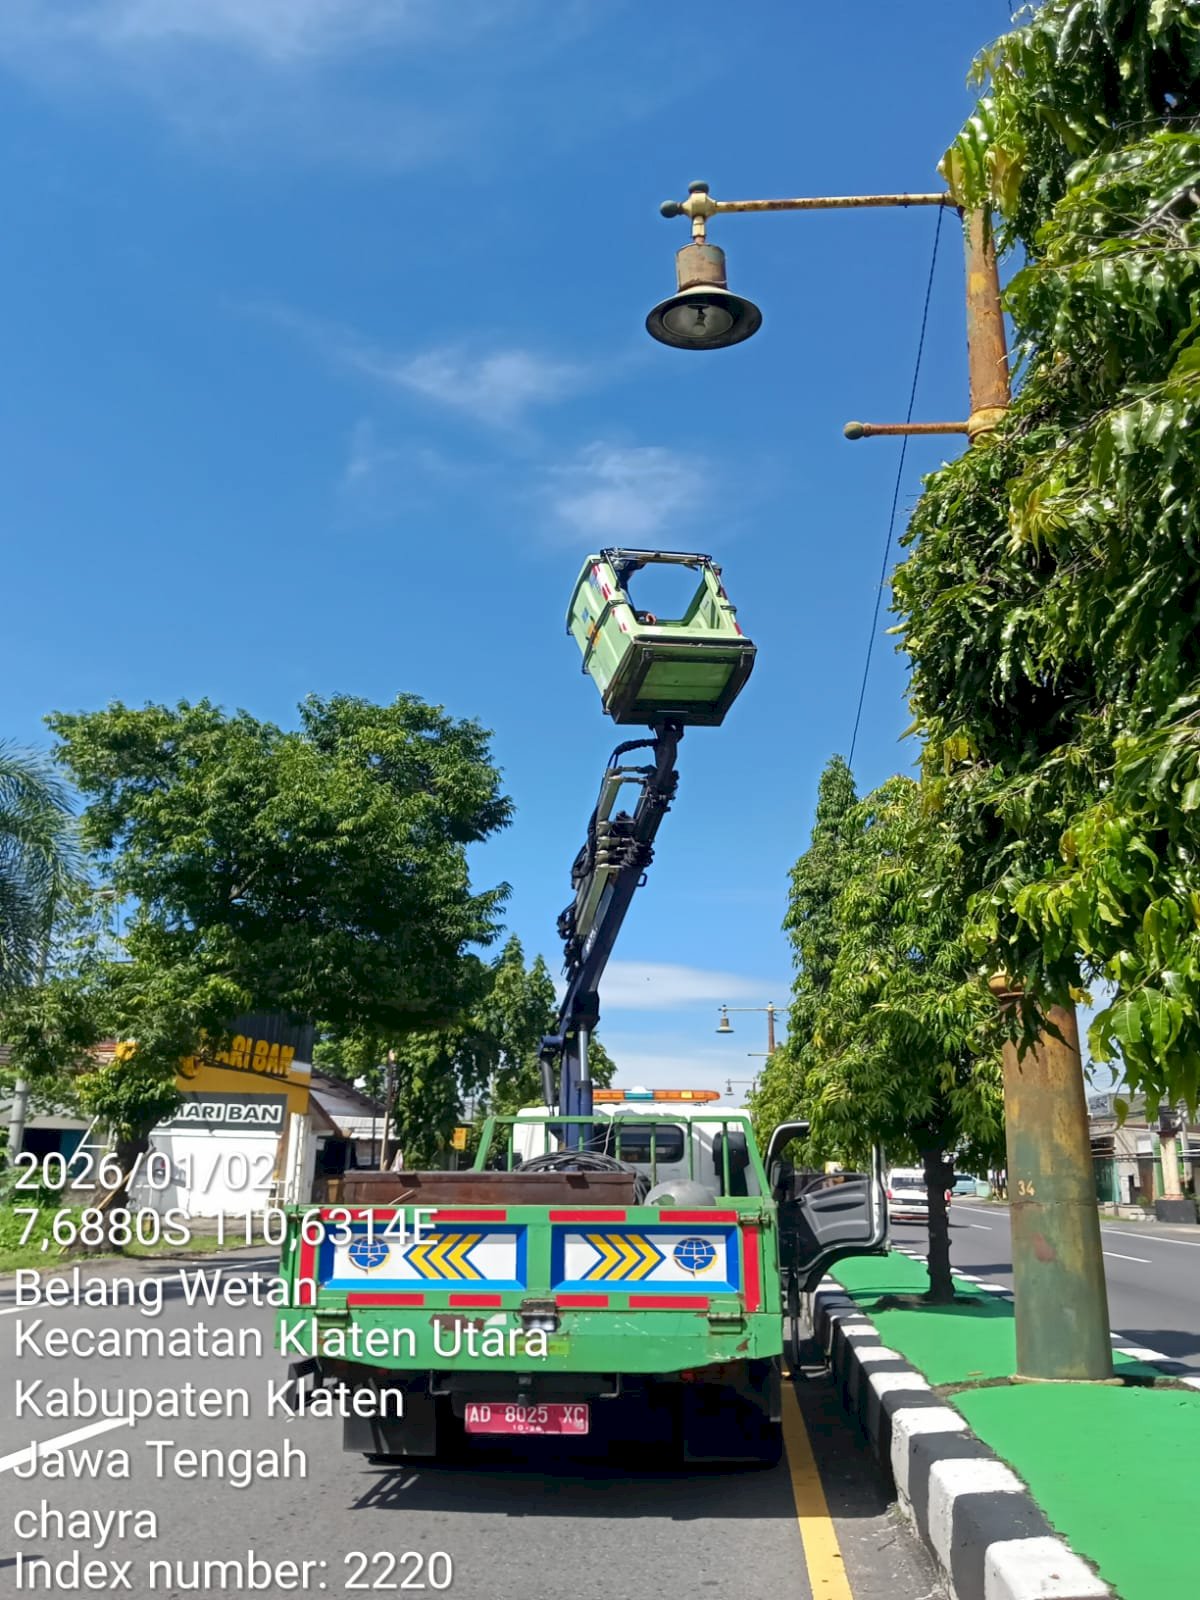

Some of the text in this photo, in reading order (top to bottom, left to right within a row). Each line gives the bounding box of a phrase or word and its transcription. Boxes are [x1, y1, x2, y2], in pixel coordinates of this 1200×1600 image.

[225, 1104, 283, 1124] BAN
[1018, 1180, 1035, 1196] 34
[470, 1406, 584, 1424] AD 8025 XC
